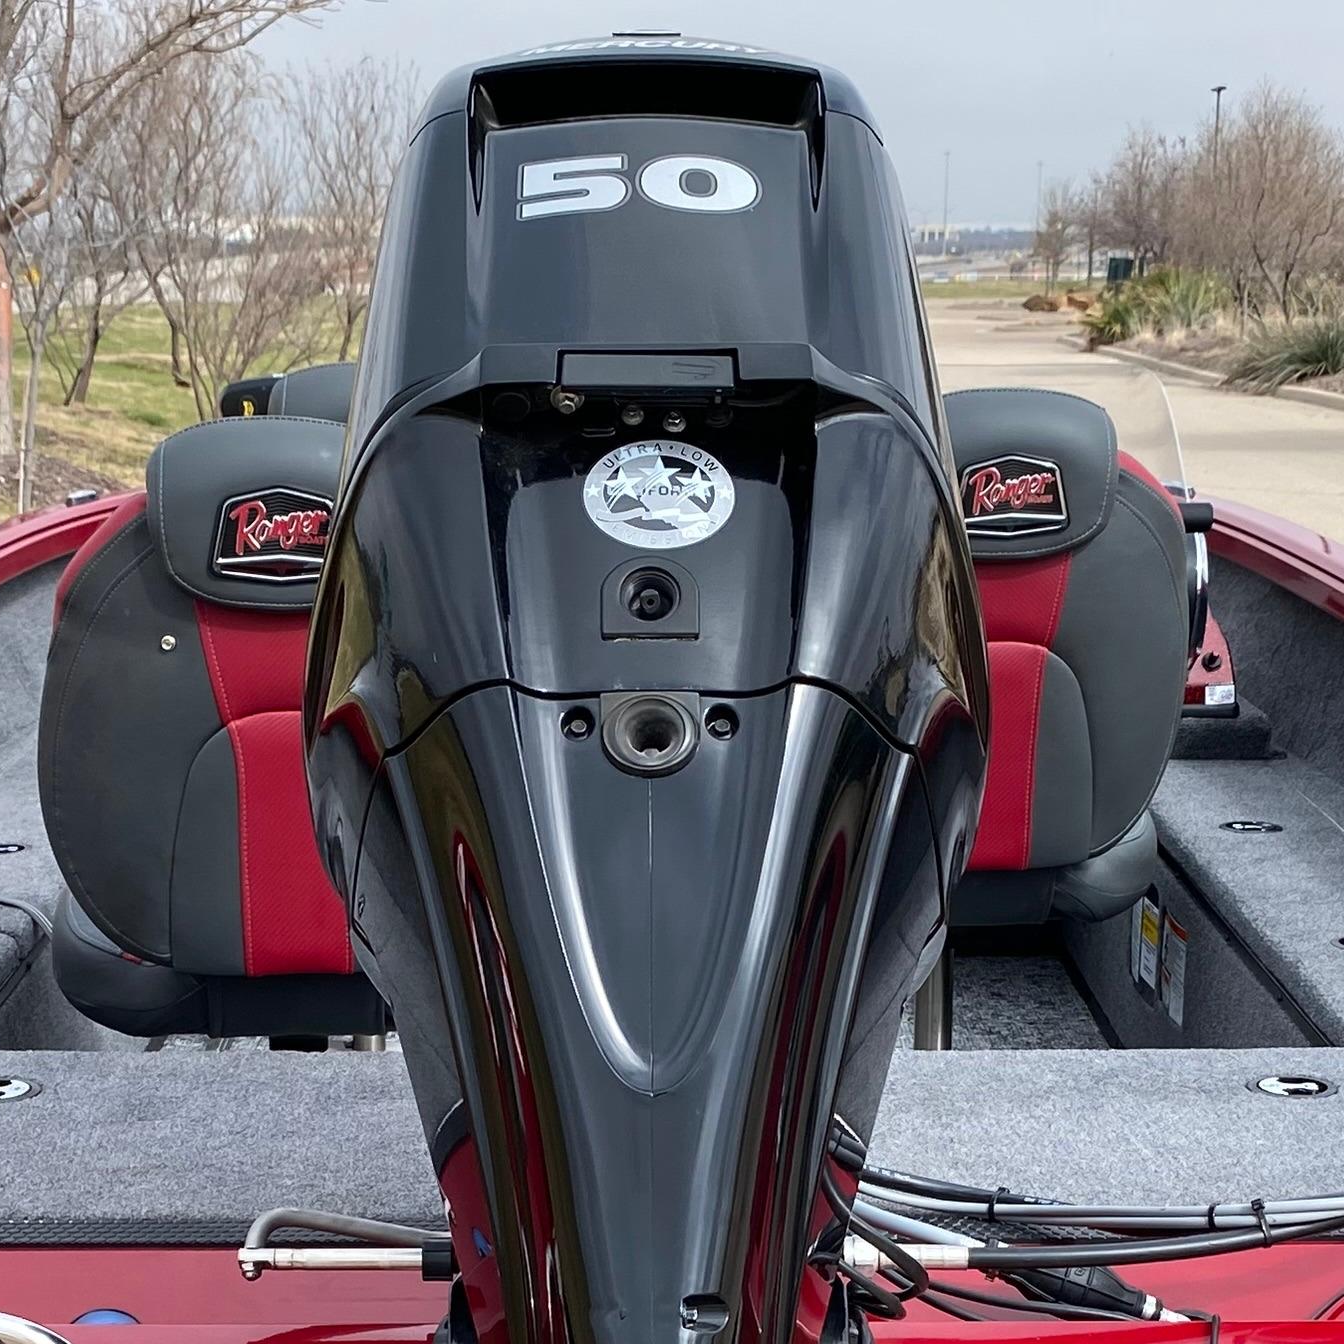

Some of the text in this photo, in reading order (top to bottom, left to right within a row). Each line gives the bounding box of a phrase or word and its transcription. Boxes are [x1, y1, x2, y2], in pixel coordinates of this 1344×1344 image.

[514, 152, 764, 222] 50
[602, 442, 719, 472] ULTRA LOW
[968, 466, 1056, 516] Ranger
[228, 499, 329, 556] Ranger
